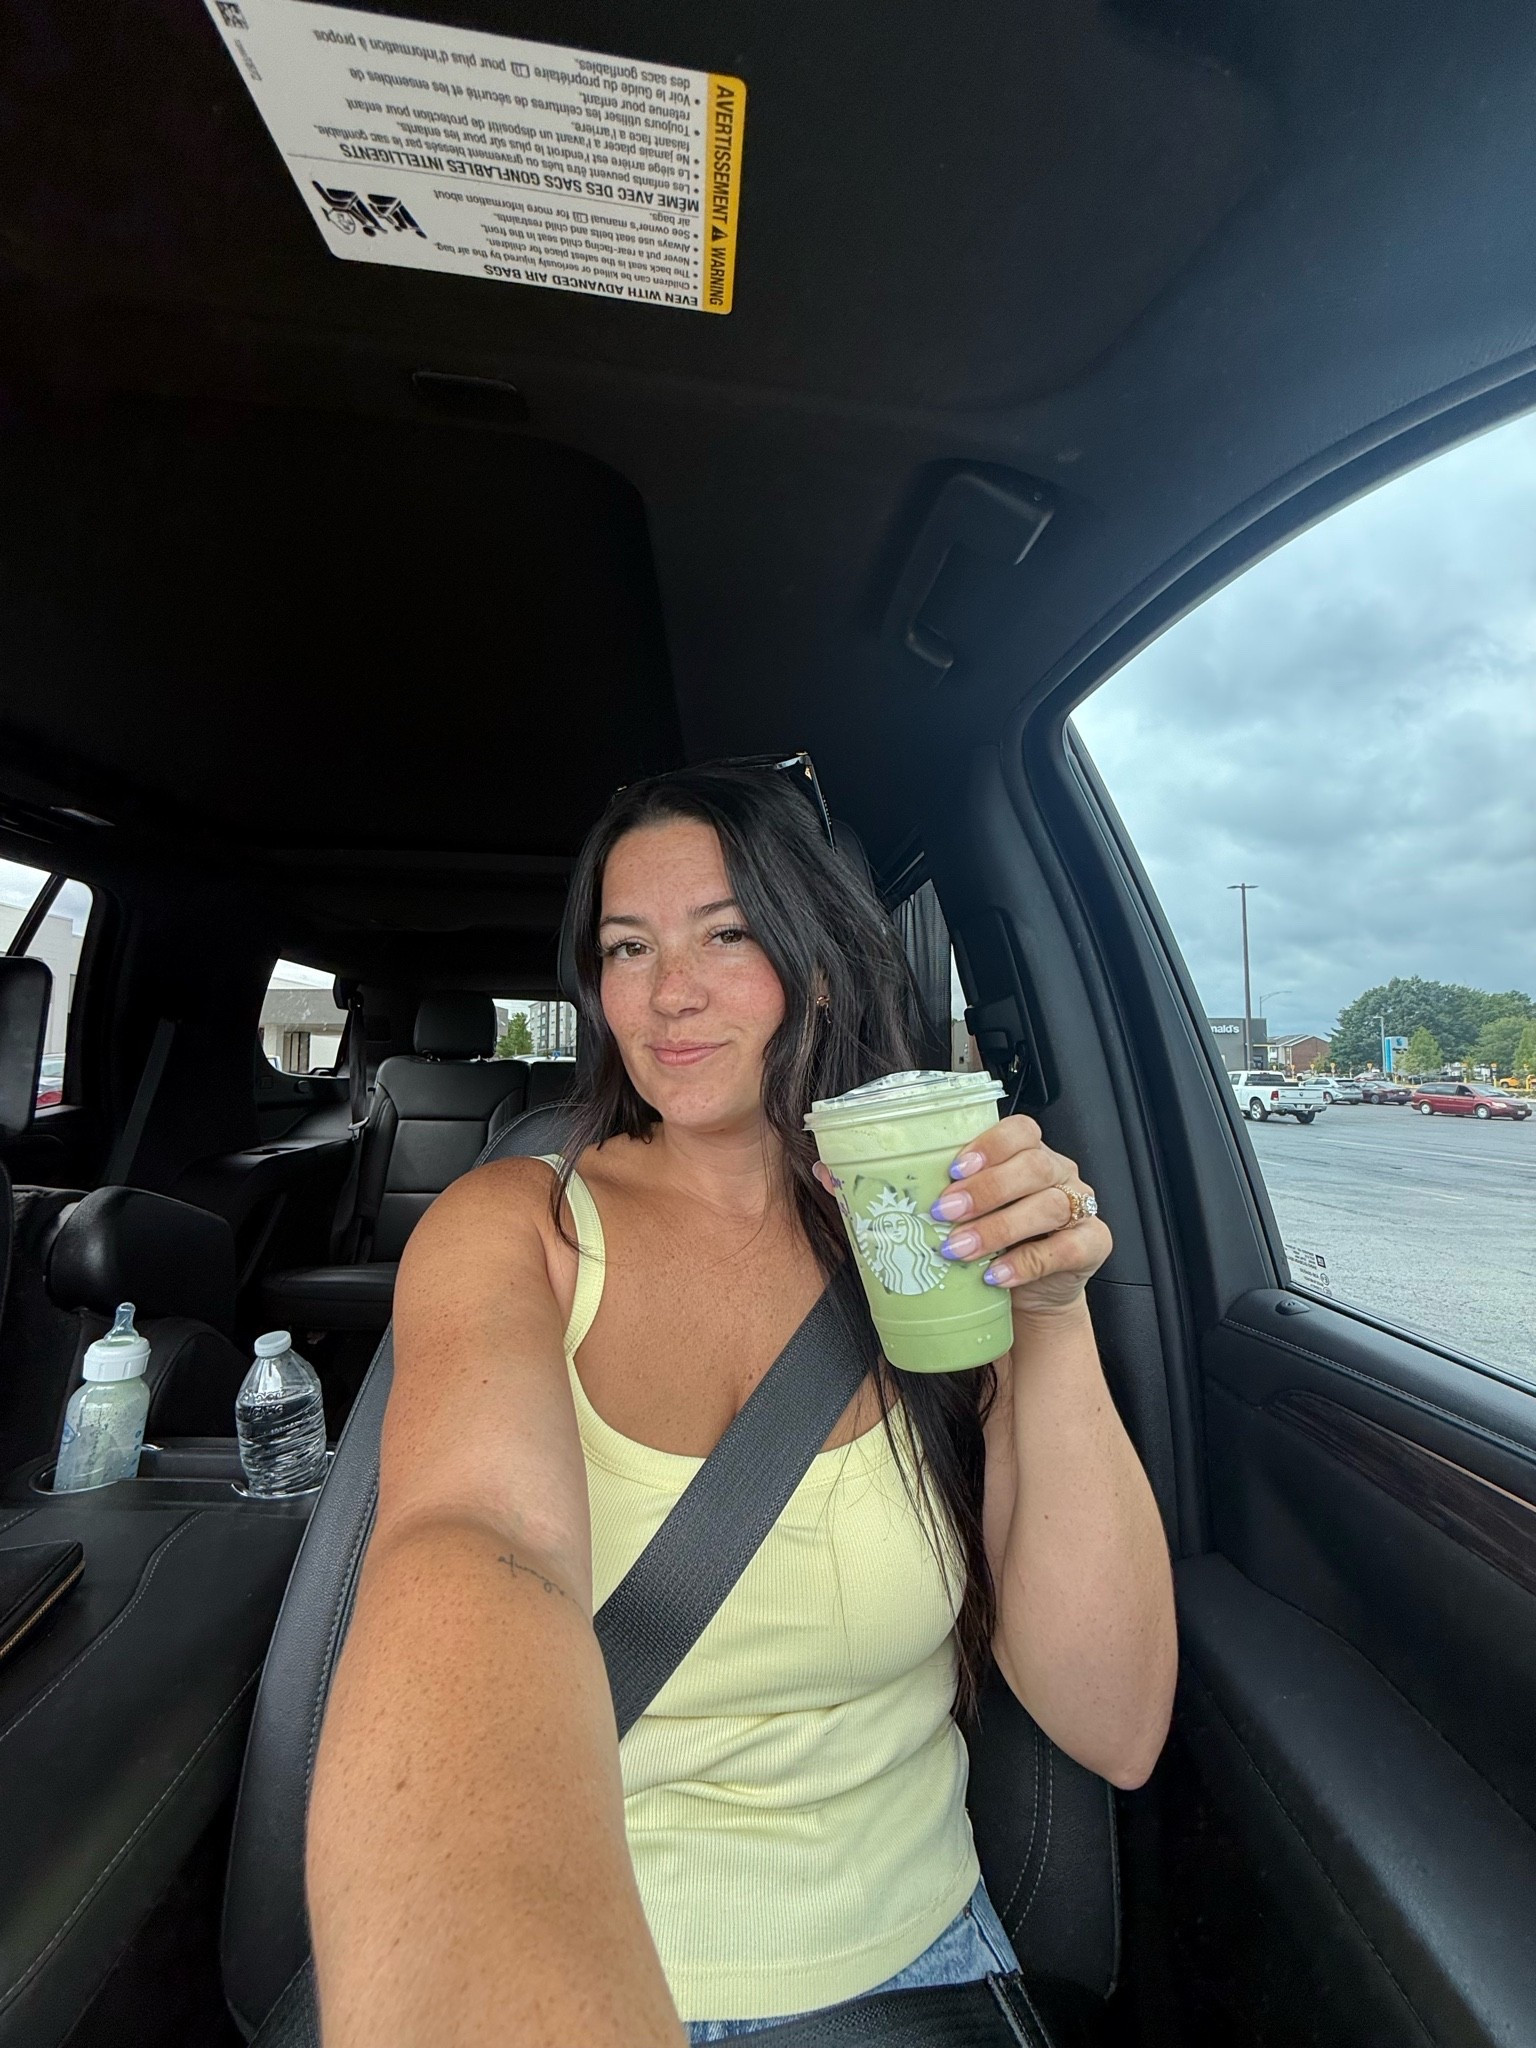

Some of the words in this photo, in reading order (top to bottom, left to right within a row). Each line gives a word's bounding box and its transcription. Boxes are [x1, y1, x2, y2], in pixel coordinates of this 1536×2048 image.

[369, 38, 449, 64] d'information
[450, 52, 477, 68] plus
[480, 57, 507, 72] pour
[349, 68, 365, 82] de
[575, 59, 638, 80] gonflables.
[366, 71, 430, 90] ensembles
[534, 67, 600, 88] propriétaire
[640, 71, 667, 85] sacs
[670, 76, 691, 92] des
[431, 81, 450, 97] les
[450, 84, 464, 97] et
[603, 79, 618, 93] du
[621, 82, 653, 100] Guide
[466, 87, 512, 106] sécurité
[514, 95, 529, 109] de
[579, 92, 618, 108] enfant.
[655, 88, 666, 103] le
[668, 91, 691, 107] Voir
[345, 98, 383, 113] enfant
[385, 104, 411, 117] pour
[530, 98, 583, 116] ceintures
[620, 100, 646, 113] pour
[412, 109, 469, 126] protection
[585, 107, 602, 122] les
[604, 111, 642, 127] utiliser
[648, 104, 690, 122] retenue
[396, 122, 441, 137] enfants.
[470, 117, 486, 131] de
[488, 121, 537, 139] dispositif
[644, 118, 690, 137] Toujours
[369, 132, 390, 144] sac
[443, 128, 461, 143] les
[463, 132, 487, 144] pour
[539, 130, 554, 140] un
[555, 132, 592, 149] l'avant
[628, 131, 652, 146] face
[391, 136, 404, 149] le
[405, 138, 423, 149] par
[424, 141, 467, 158] blessés
[489, 137, 507, 149] sûr
[508, 139, 532, 153] plus
[534, 143, 545, 156] le
[603, 140, 637, 156] placer
[654, 136, 690, 153] faisant
[339, 143, 444, 171] INTELLIGENTS
[467, 147, 524, 165] gravement
[546, 145, 590, 163] l'endroit
[592, 153, 609, 165] est
[639, 146, 674, 163] jamais
[676, 153, 690, 166] Ne
[711, 84, 735, 224] AVERTISSEMENT
[525, 157, 540, 168] ou
[541, 159, 565, 173] tués
[611, 156, 645, 171] arrière
[648, 162, 675, 177] siège
[446, 159, 541, 186] GONFLABLES
[566, 164, 587, 178] être
[589, 168, 630, 183] peuvent
[678, 168, 690, 181] Le
[543, 175, 582, 193] SACS
[632, 175, 670, 190] enfants
[672, 182, 690, 195] Les
[433, 189, 464, 203] about
[585, 182, 614, 199] DES
[617, 187, 654, 205] AVEC
[465, 195, 525, 213] information
[526, 204, 553, 216] more
[657, 193, 700, 213] MÊME
[493, 213, 543, 228] restraints.
[556, 209, 570, 220] for
[590, 215, 628, 228] manual
[649, 212, 676, 226] bags.
[544, 221, 568, 233] child
[629, 221, 670, 235] owner's
[677, 217, 691, 227] air
[480, 224, 507, 237] front.
[508, 228, 525, 239] the
[525, 231, 536, 241] in
[570, 225, 588, 235] and
[590, 228, 614, 242] belts
[671, 228, 690, 240] See
[537, 233, 558, 243] seat
[559, 236, 583, 248] child
[615, 232, 636, 243] seat
[638, 236, 655, 246] use
[457, 246, 470, 256] air
[486, 238, 527, 252] children.
[529, 245, 543, 255] for
[584, 239, 636, 256] rear-facing
[657, 239, 691, 253] Always
[471, 248, 489, 259] the
[489, 249, 502, 261] by
[502, 253, 537, 266] injured
[543, 247, 569, 258] place
[570, 251, 599, 263] safest
[646, 251, 662, 260] put
[538, 257, 580, 272] seriously
[600, 256, 616, 267] the
[617, 259, 626, 269] is
[628, 261, 648, 271] seat
[663, 254, 690, 267] Never
[483, 264, 522, 280] BAGS
[581, 265, 592, 274] or
[593, 267, 619, 280] killed
[649, 264, 672, 276] back
[673, 268, 690, 279] The
[709, 247, 727, 306] WARNING
[524, 270, 548, 284] AIR
[620, 272, 633, 282] be
[633, 274, 651, 283] can
[652, 277, 690, 290] Children
[551, 274, 624, 295] ADVANCED
[627, 286, 662, 301] WITH
[664, 292, 698, 307] EVEN
[1211, 1024, 1240, 1034] nald's
